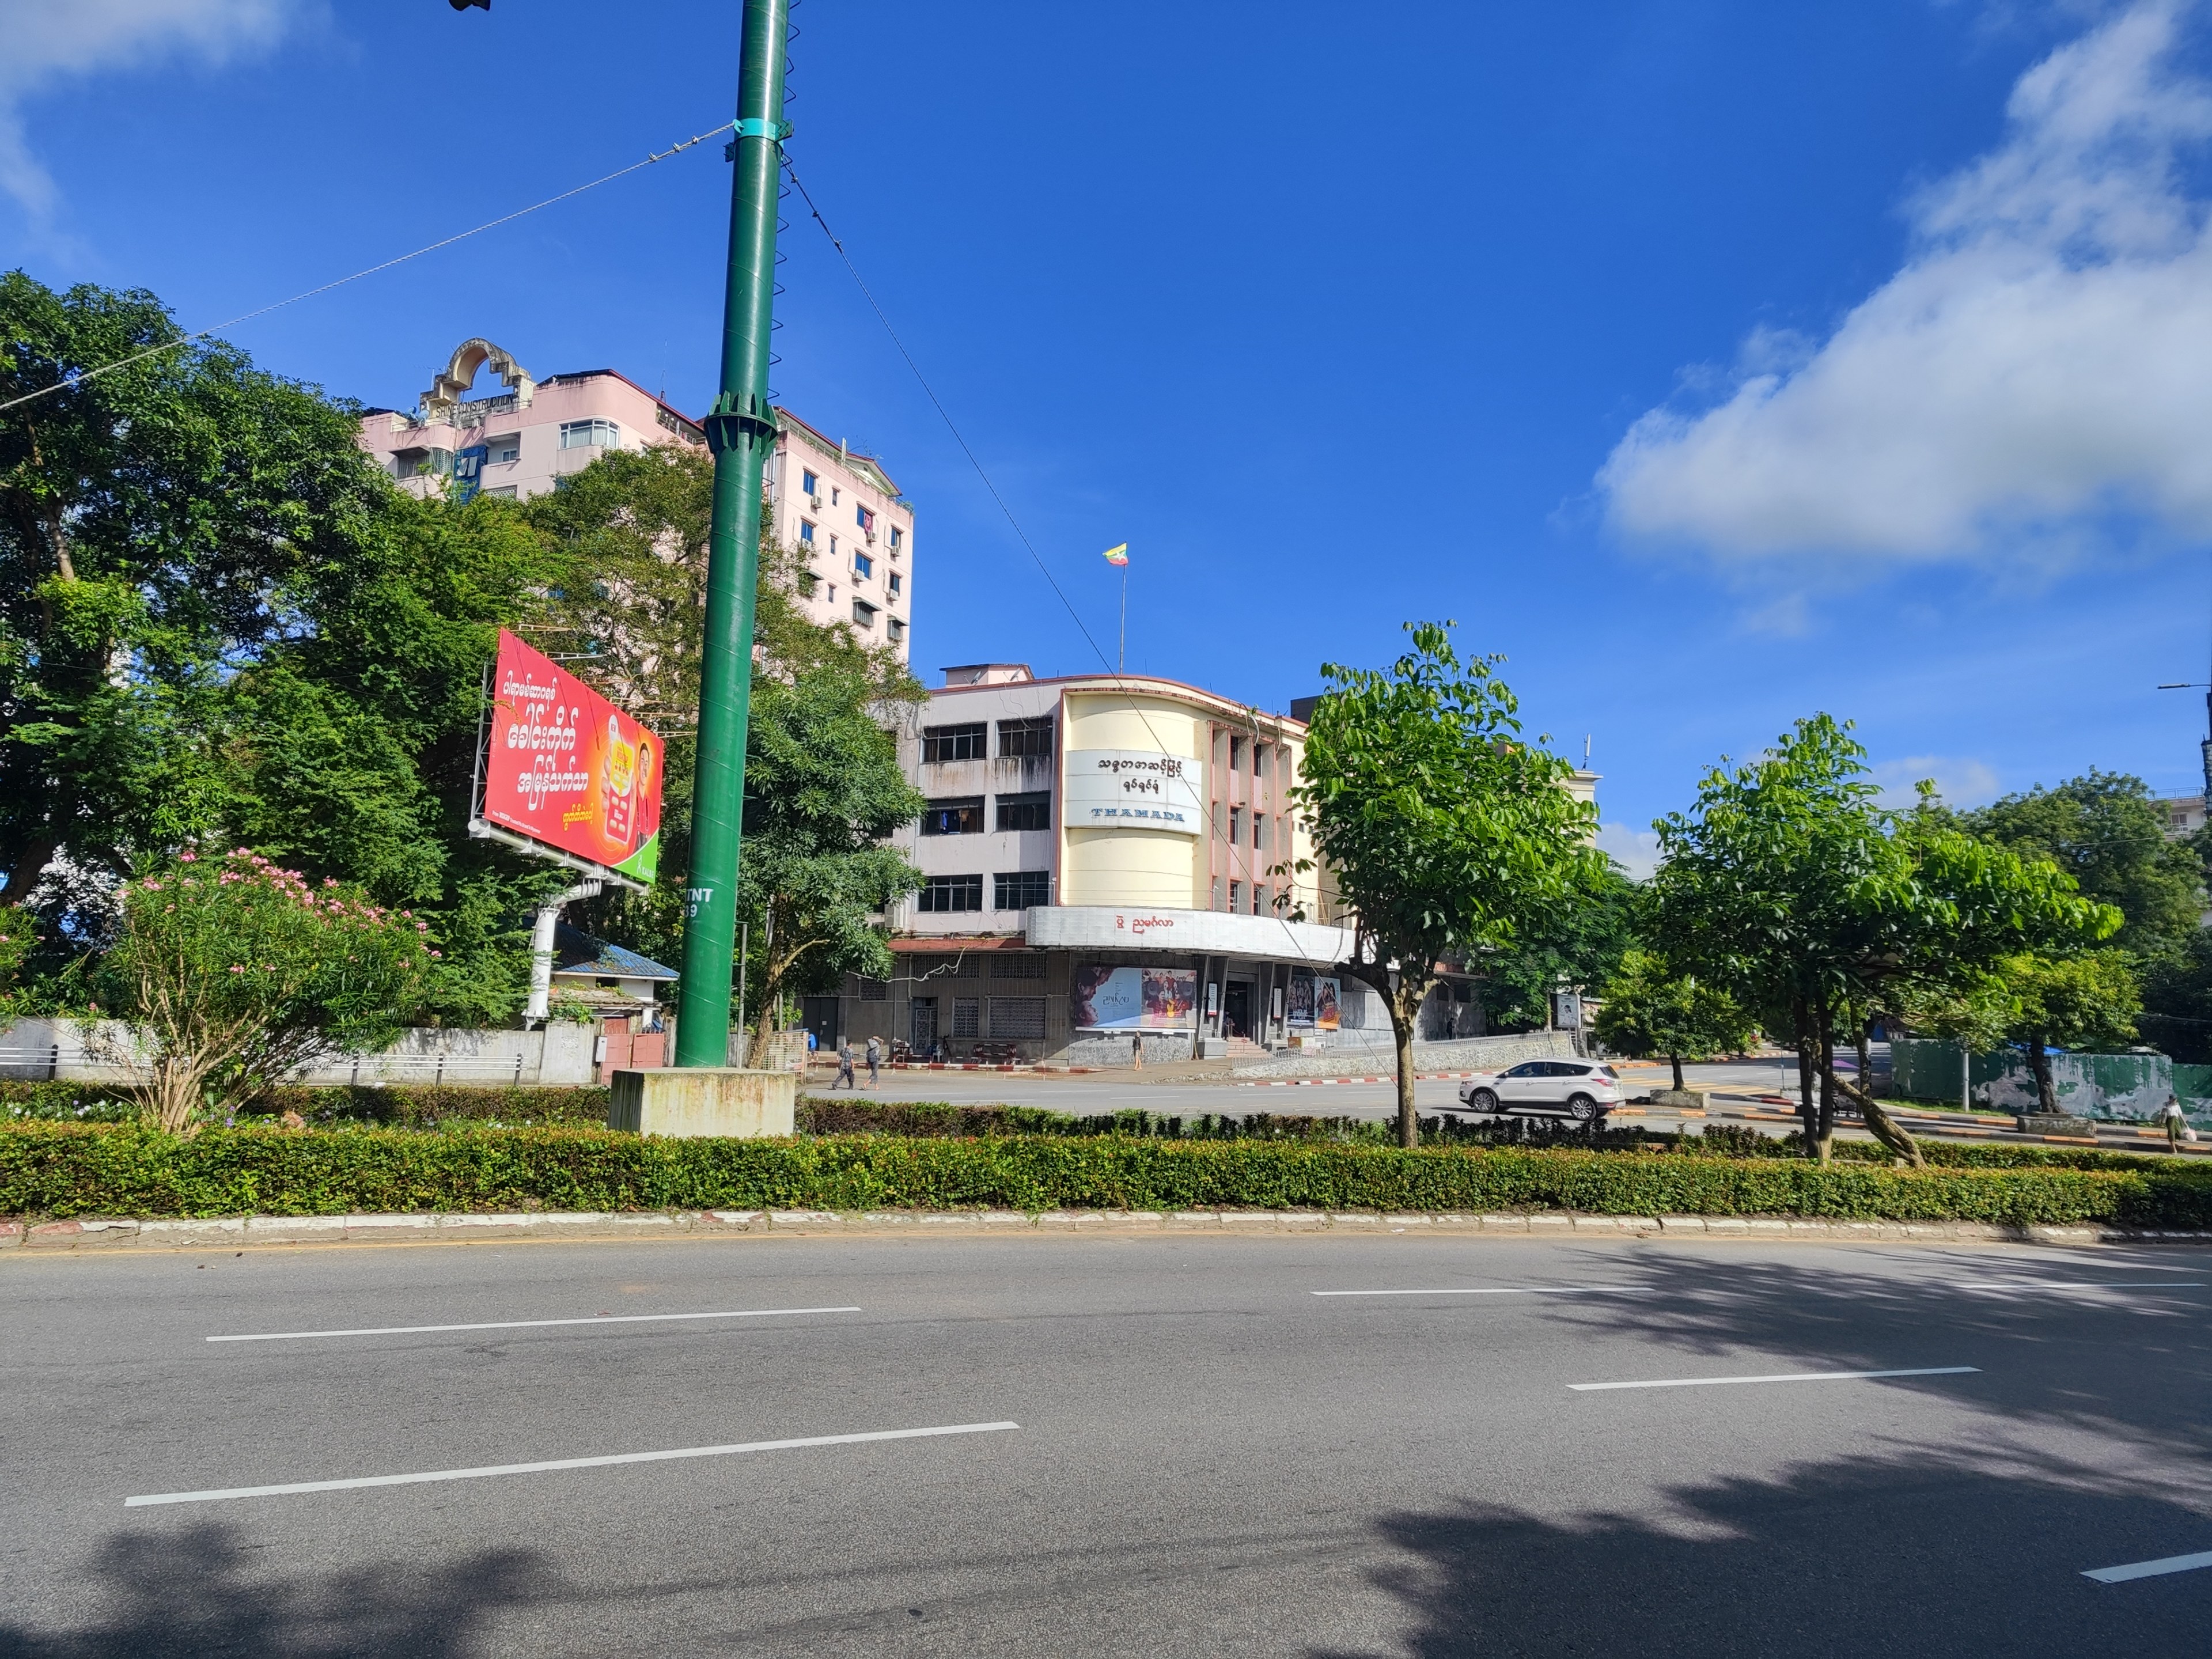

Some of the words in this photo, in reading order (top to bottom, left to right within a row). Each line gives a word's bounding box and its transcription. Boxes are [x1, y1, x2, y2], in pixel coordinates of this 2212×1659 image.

[436, 404, 457, 417] SHINE
[459, 393, 513, 414] CONSTRUCTION
[1091, 808, 1185, 823] THAMADA
